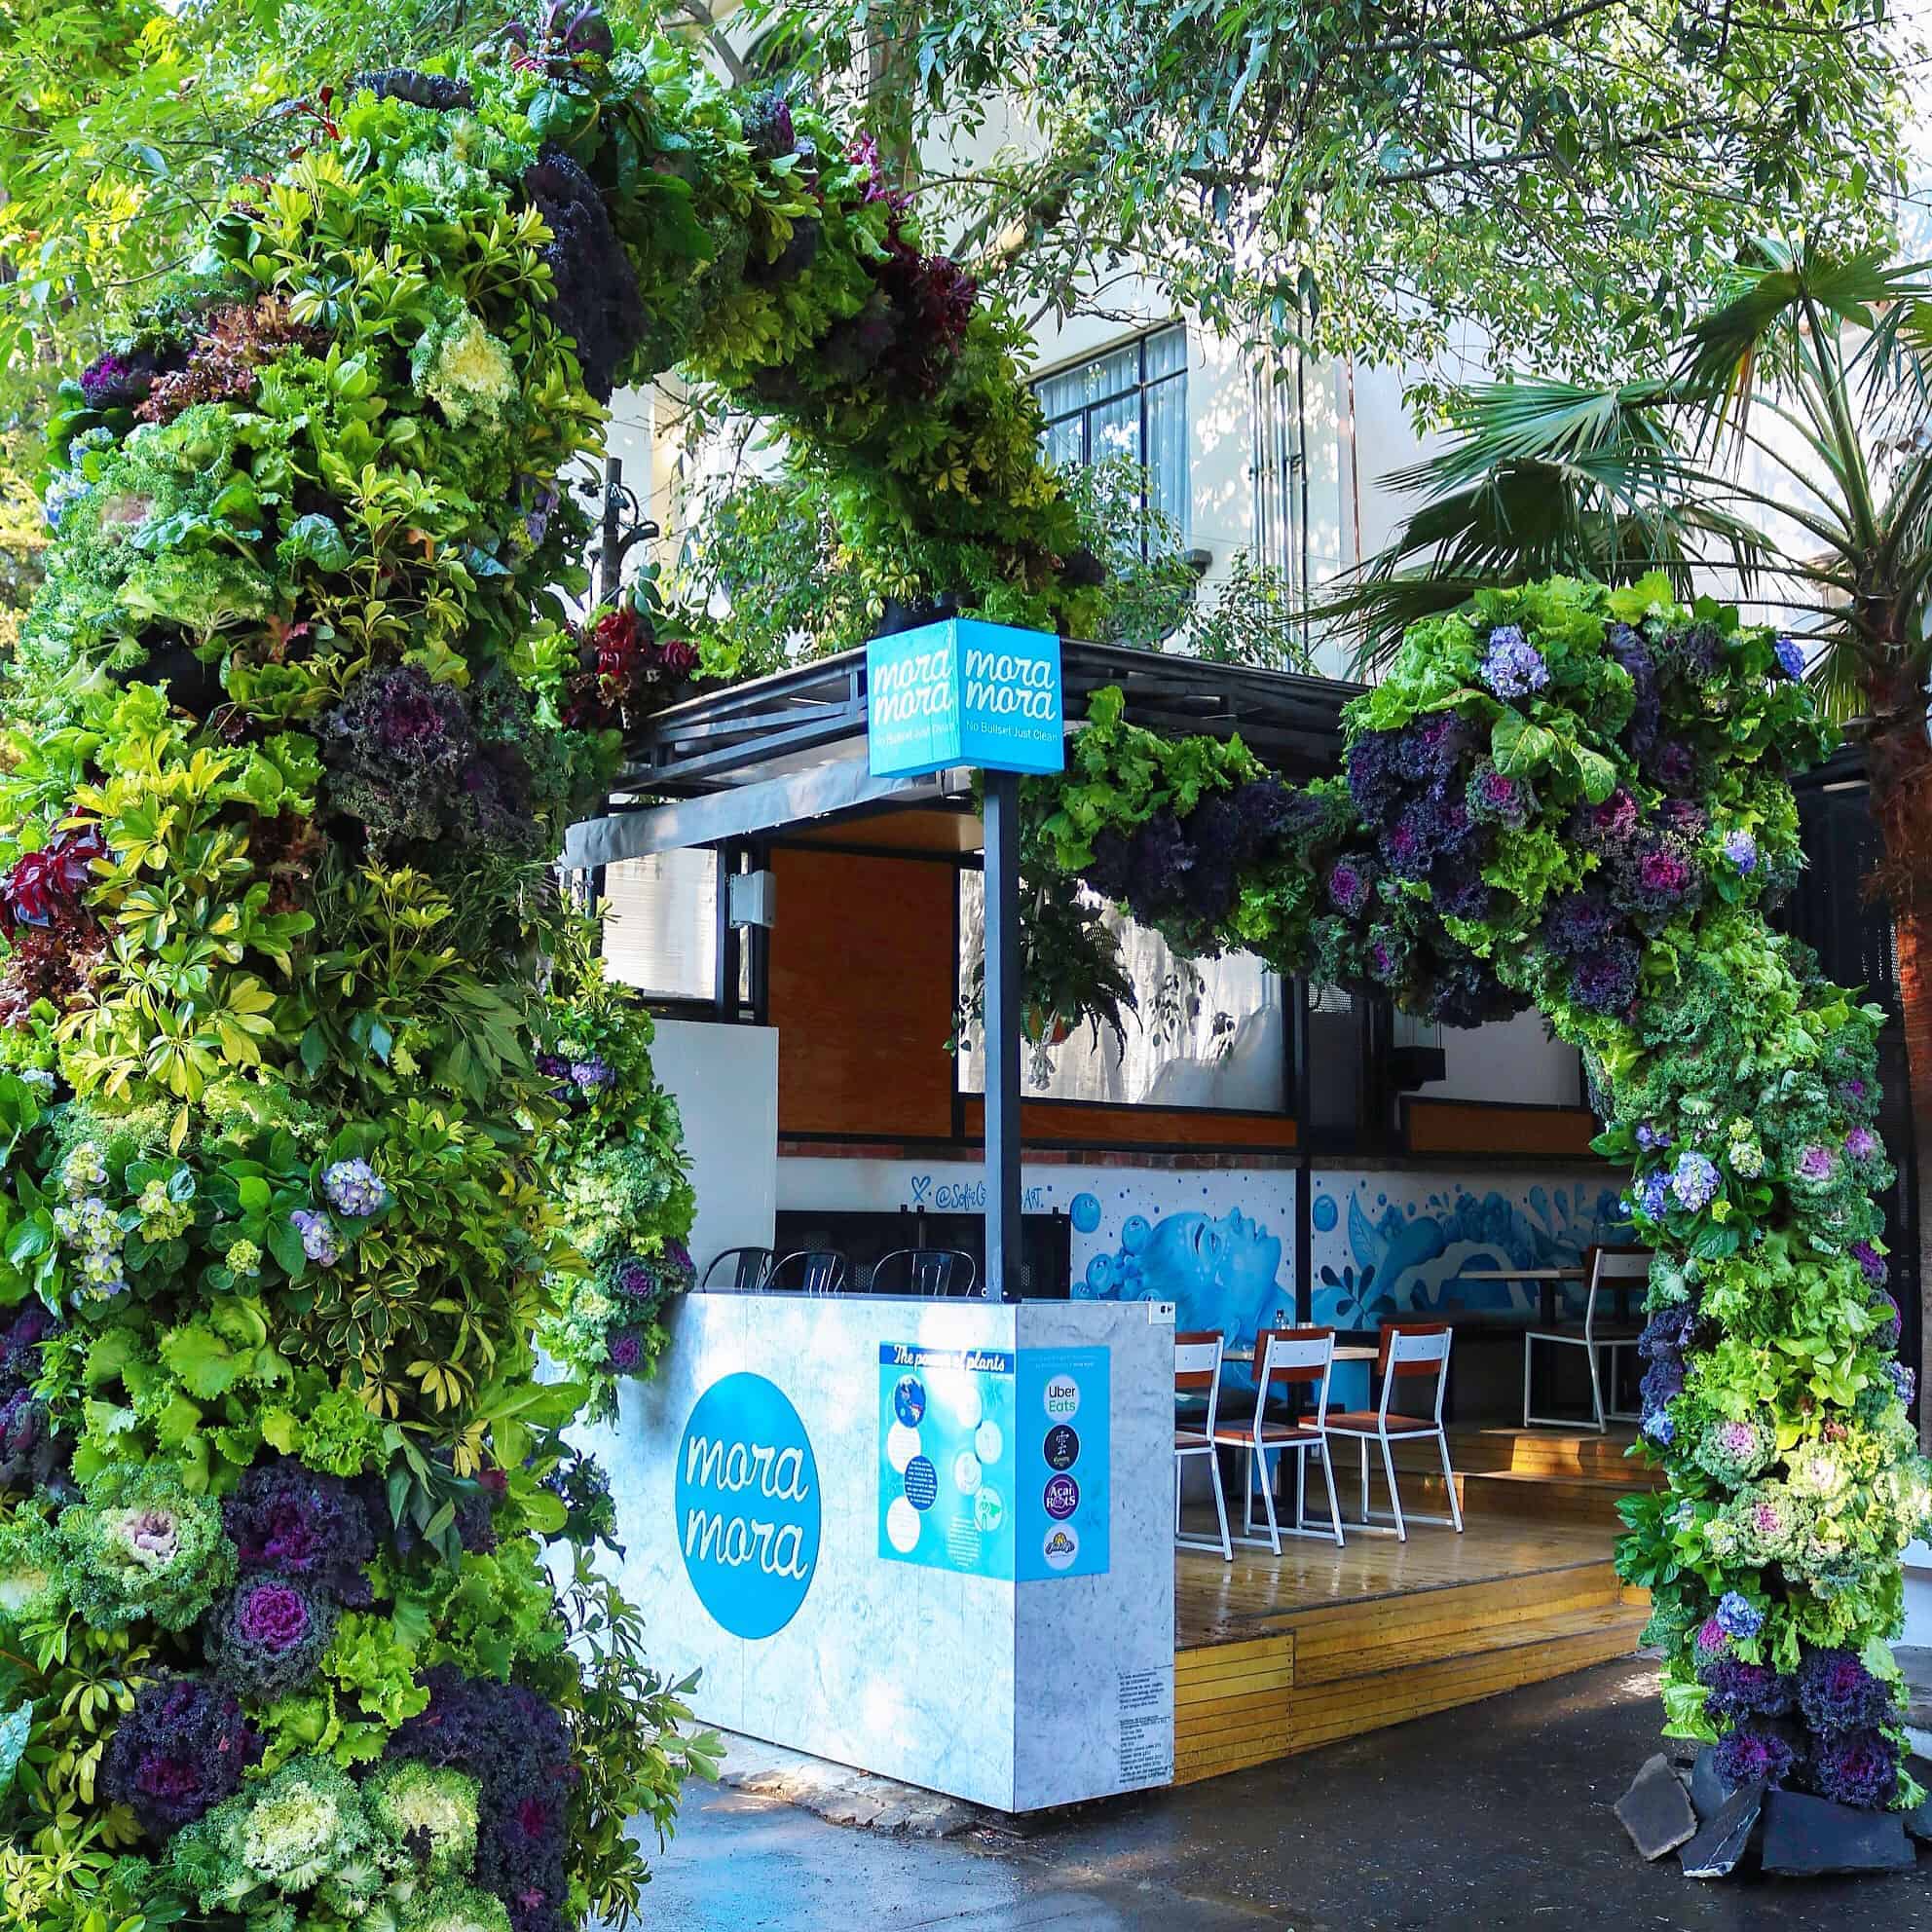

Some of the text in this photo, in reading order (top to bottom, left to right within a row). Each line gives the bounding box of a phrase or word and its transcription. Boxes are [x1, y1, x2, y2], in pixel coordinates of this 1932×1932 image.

[873, 649, 952, 693] mora
[965, 649, 1056, 689] mora
[873, 682, 954, 725] mora
[965, 681, 1057, 721] mora
[966, 720, 980, 732] No
[1032, 728, 1059, 741] Clean
[894, 1344, 914, 1364] The
[966, 1350, 1006, 1372] plants
[1049, 1386, 1076, 1398] Uber
[1049, 1400, 1076, 1412] Eats
[685, 1435, 809, 1503] mora
[685, 1507, 809, 1580] mora
